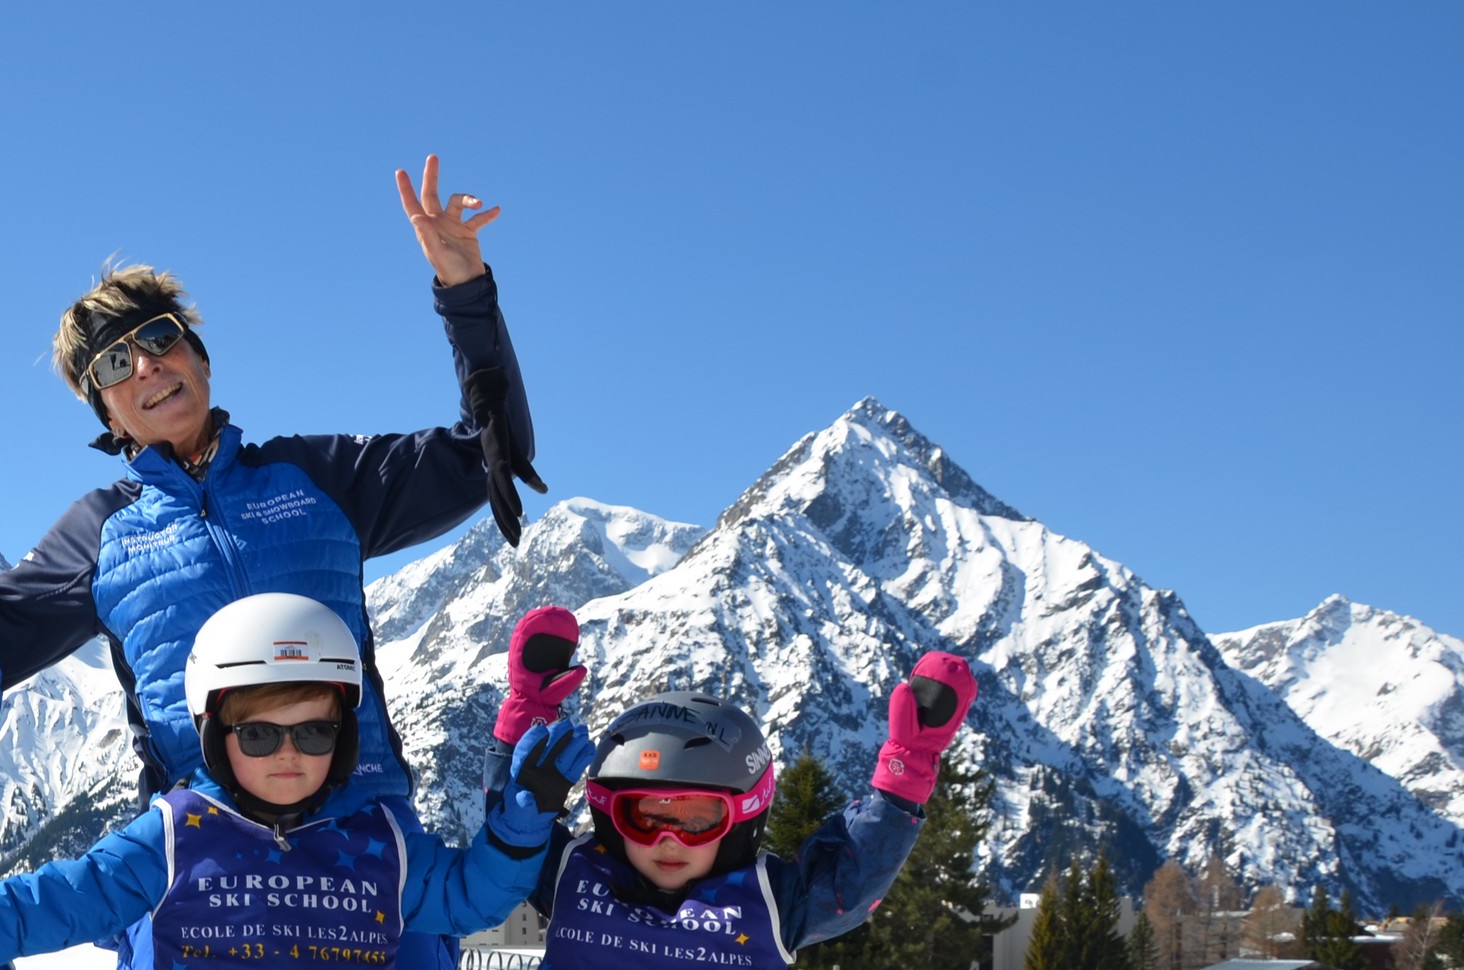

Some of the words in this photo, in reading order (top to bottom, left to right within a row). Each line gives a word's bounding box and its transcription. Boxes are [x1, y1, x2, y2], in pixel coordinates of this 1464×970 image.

[240, 511, 255, 520] SKI
[263, 497, 317, 517] SNOWBOARD
[246, 489, 305, 511] EUROPEAN
[261, 509, 307, 525] SCHOOL
[197, 874, 378, 897] EUROPEAN
[209, 893, 251, 908] SKI
[266, 892, 372, 914] SCHOOL
[577, 898, 614, 916] SKI
[180, 925, 235, 939] ECOLE
[242, 924, 266, 937] DE
[272, 924, 300, 937] SKI
[228, 943, 265, 960] +33
[289, 944, 301, 960] 4
[601, 933, 623, 948] DE
[629, 939, 656, 954] SKI
